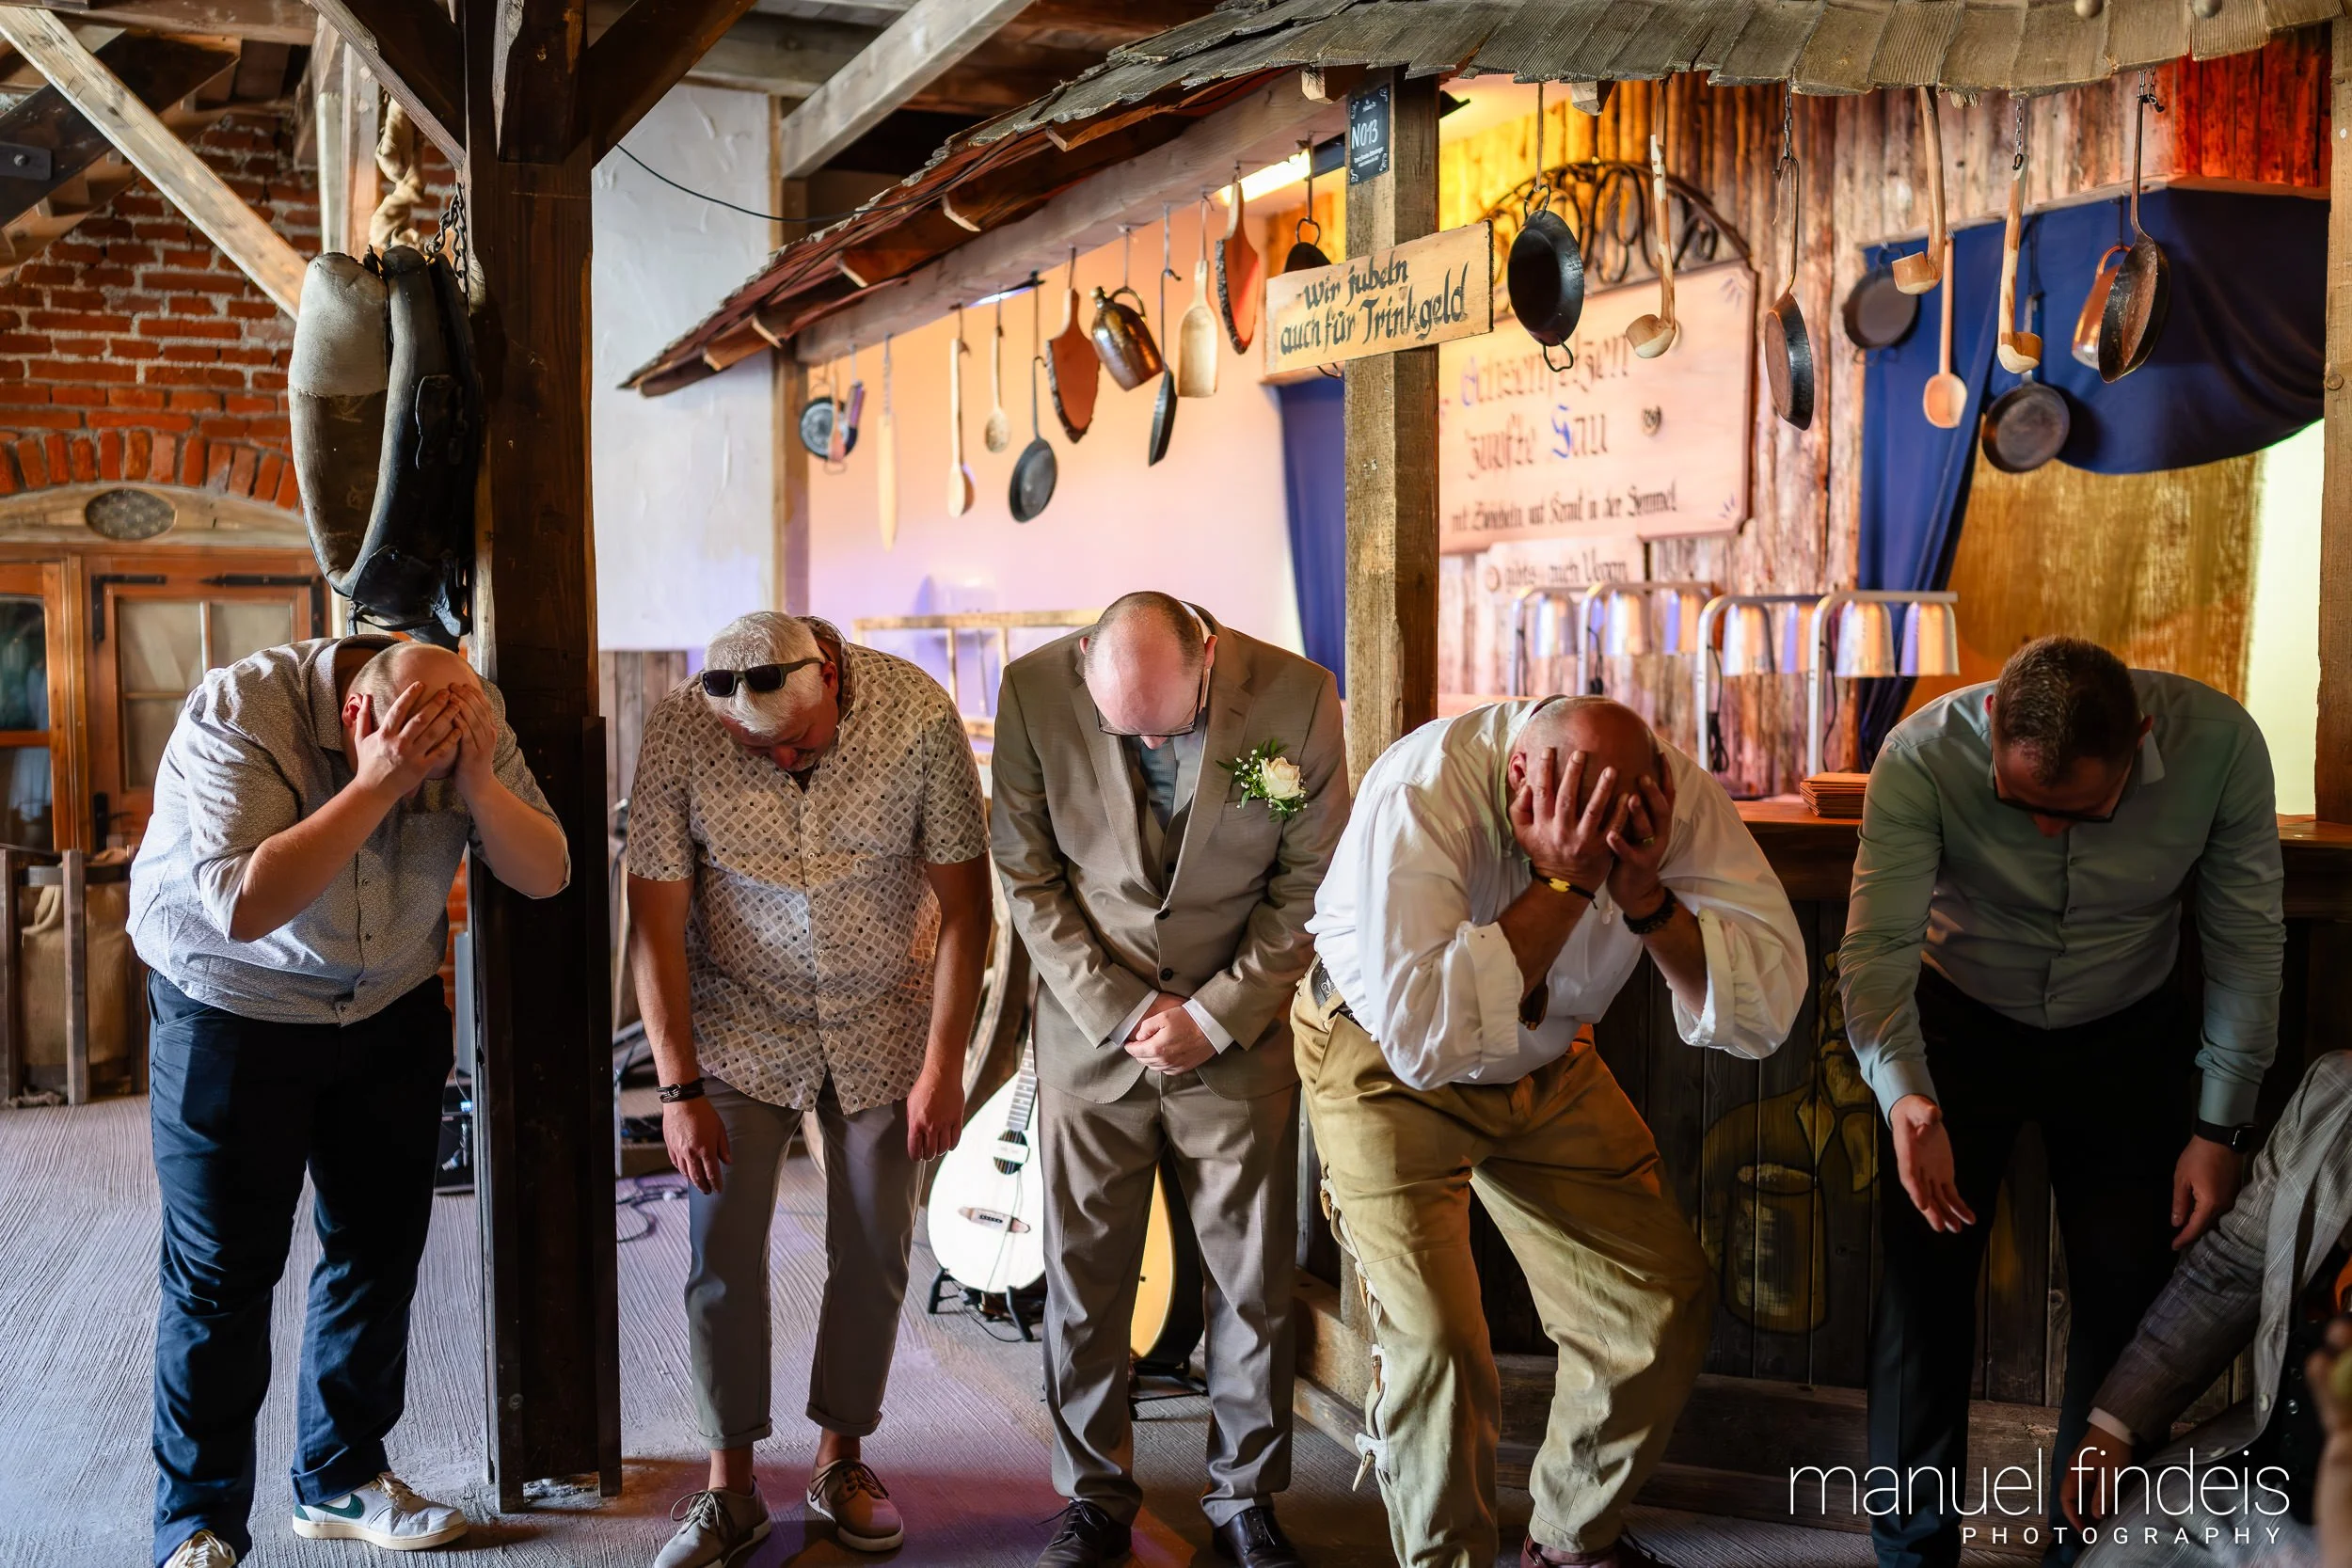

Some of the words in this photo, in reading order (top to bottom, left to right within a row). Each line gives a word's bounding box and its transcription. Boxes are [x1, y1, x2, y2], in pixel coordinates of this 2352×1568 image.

[1280, 314, 1321, 356] auch
[1323, 306, 1356, 355] für
[1359, 260, 1470, 345] Trinkgeld
[1345, 249, 1408, 308] jubeln
